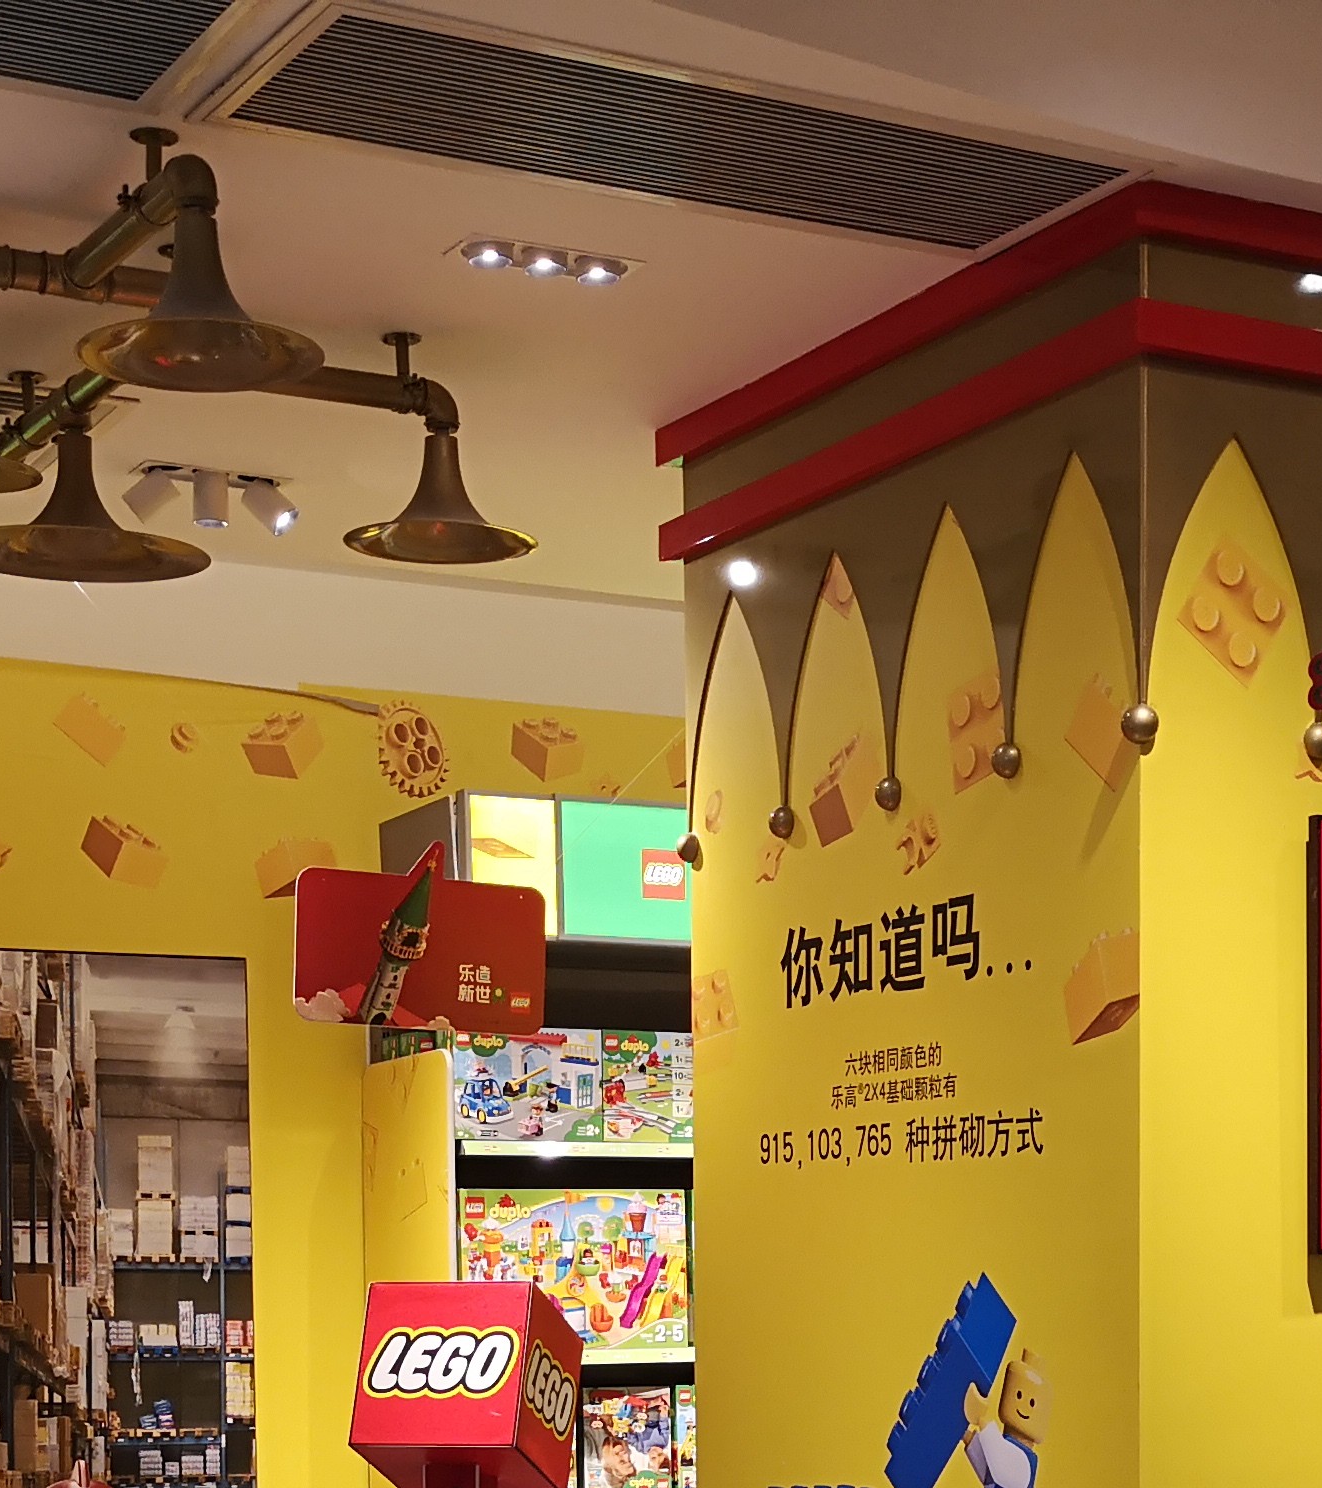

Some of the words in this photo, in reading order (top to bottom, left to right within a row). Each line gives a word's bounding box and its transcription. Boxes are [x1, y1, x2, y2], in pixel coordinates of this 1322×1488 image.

[645, 863, 685, 886] LEGO
[459, 964, 492, 984] 乐造
[458, 984, 491, 1004] 新世
[474, 1035, 503, 1048] duplo
[621, 1040, 650, 1054] duplo
[845, 1041, 942, 1077] 六块相同颜色的
[760, 1122, 892, 1169] 915,103,765
[905, 1108, 1044, 1163] 种拼砌方式
[489, 1204, 531, 1221] duplo
[654, 1325, 684, 1342] 2-5
[366, 1330, 517, 1395] LEGO
[525, 1344, 576, 1438] LEGO
